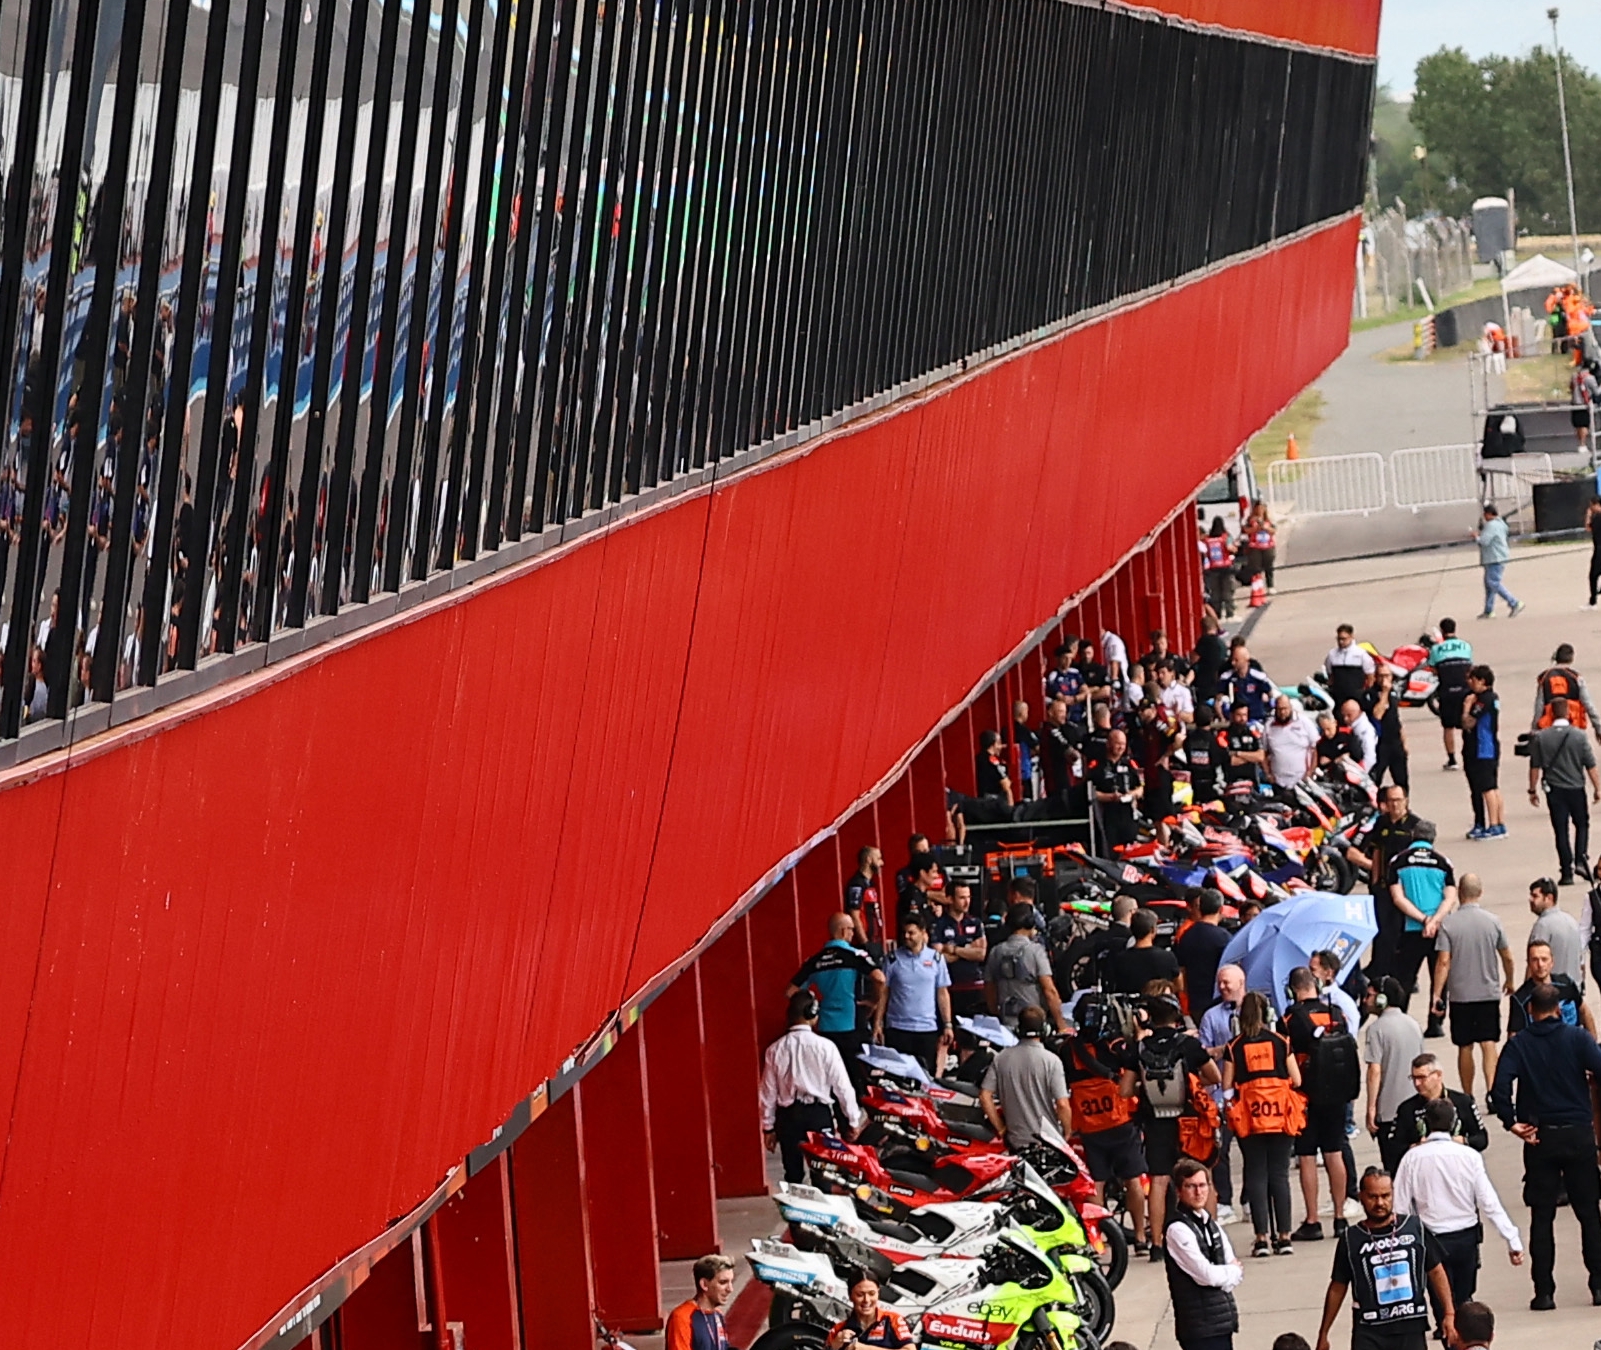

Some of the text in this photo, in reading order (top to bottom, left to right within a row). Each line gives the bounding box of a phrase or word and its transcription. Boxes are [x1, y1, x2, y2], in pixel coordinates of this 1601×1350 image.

[1080, 1096, 1113, 1117] 310
[1250, 1099, 1284, 1118] 201
[946, 1136, 971, 1147] Lenovo
[889, 1184, 914, 1197] Lenovo
[966, 1300, 1015, 1321] ebay
[1390, 1302, 1415, 1318] ARG
[929, 1319, 991, 1341] Enduro
